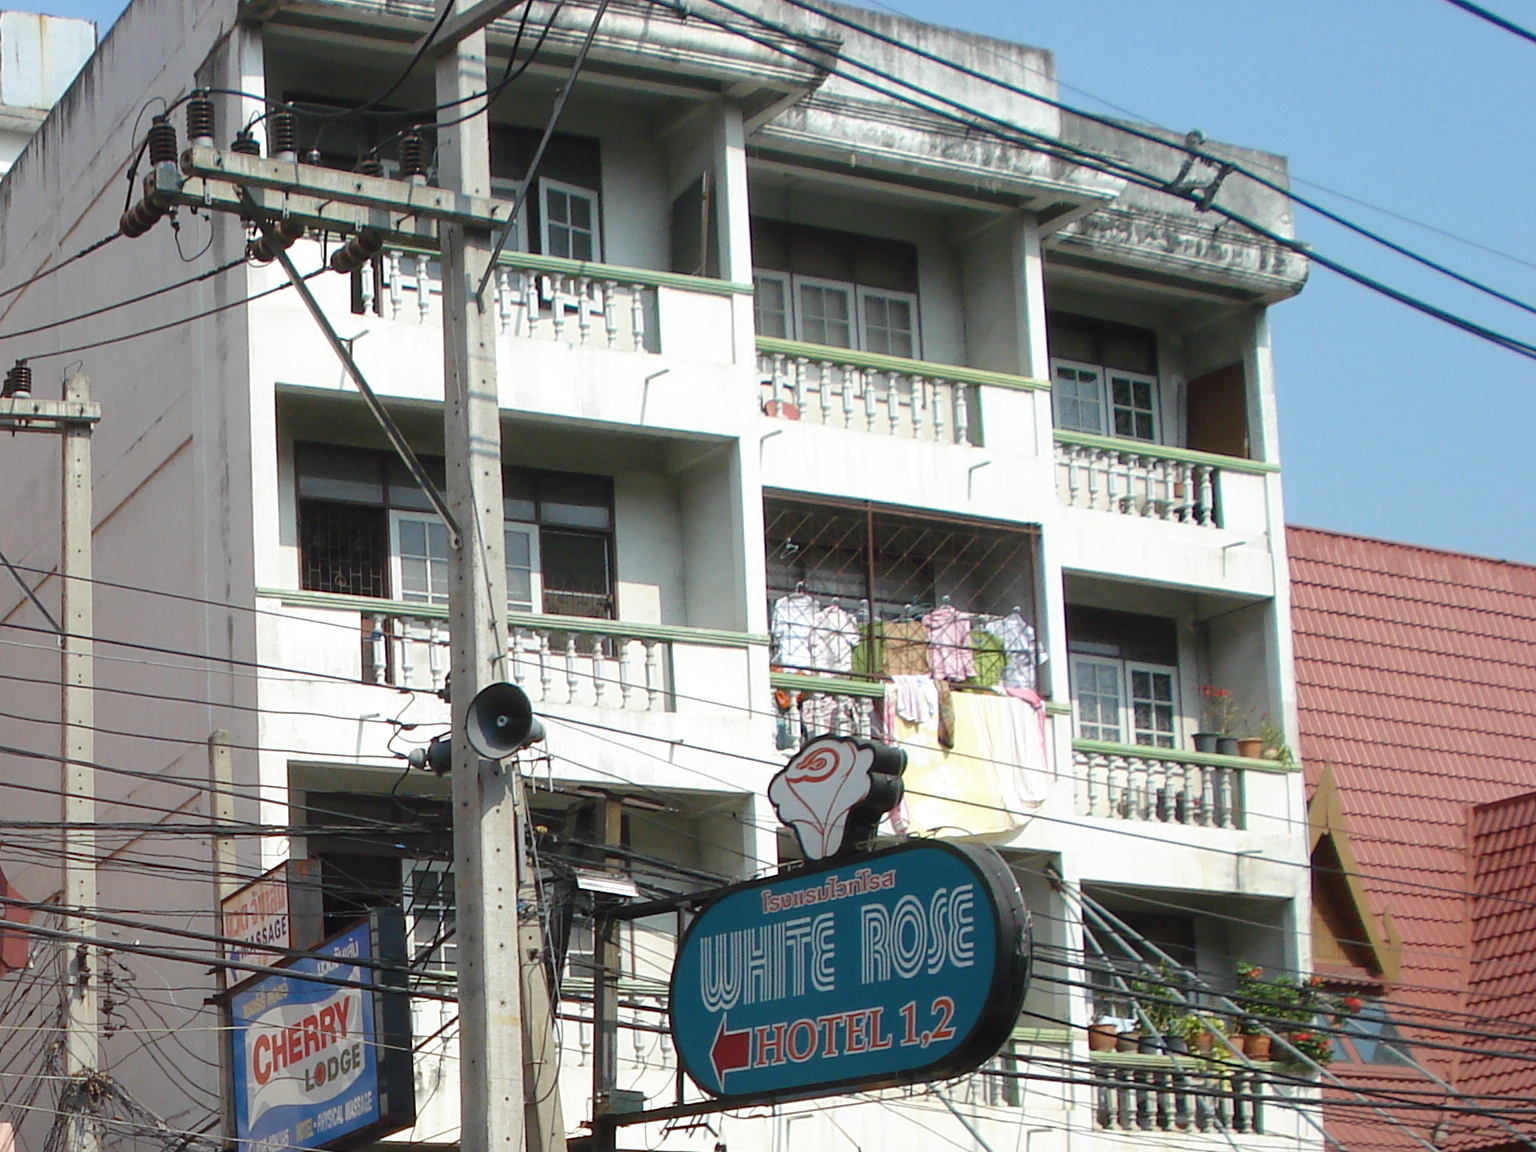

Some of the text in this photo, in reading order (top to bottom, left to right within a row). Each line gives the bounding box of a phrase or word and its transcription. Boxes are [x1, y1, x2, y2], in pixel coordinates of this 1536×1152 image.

[699, 884, 974, 1013] WHITE ROSE
[253, 995, 351, 1086] CHERRY
[305, 1043, 361, 1092] LODGE
[753, 995, 957, 1069] HOTEL 1,2
